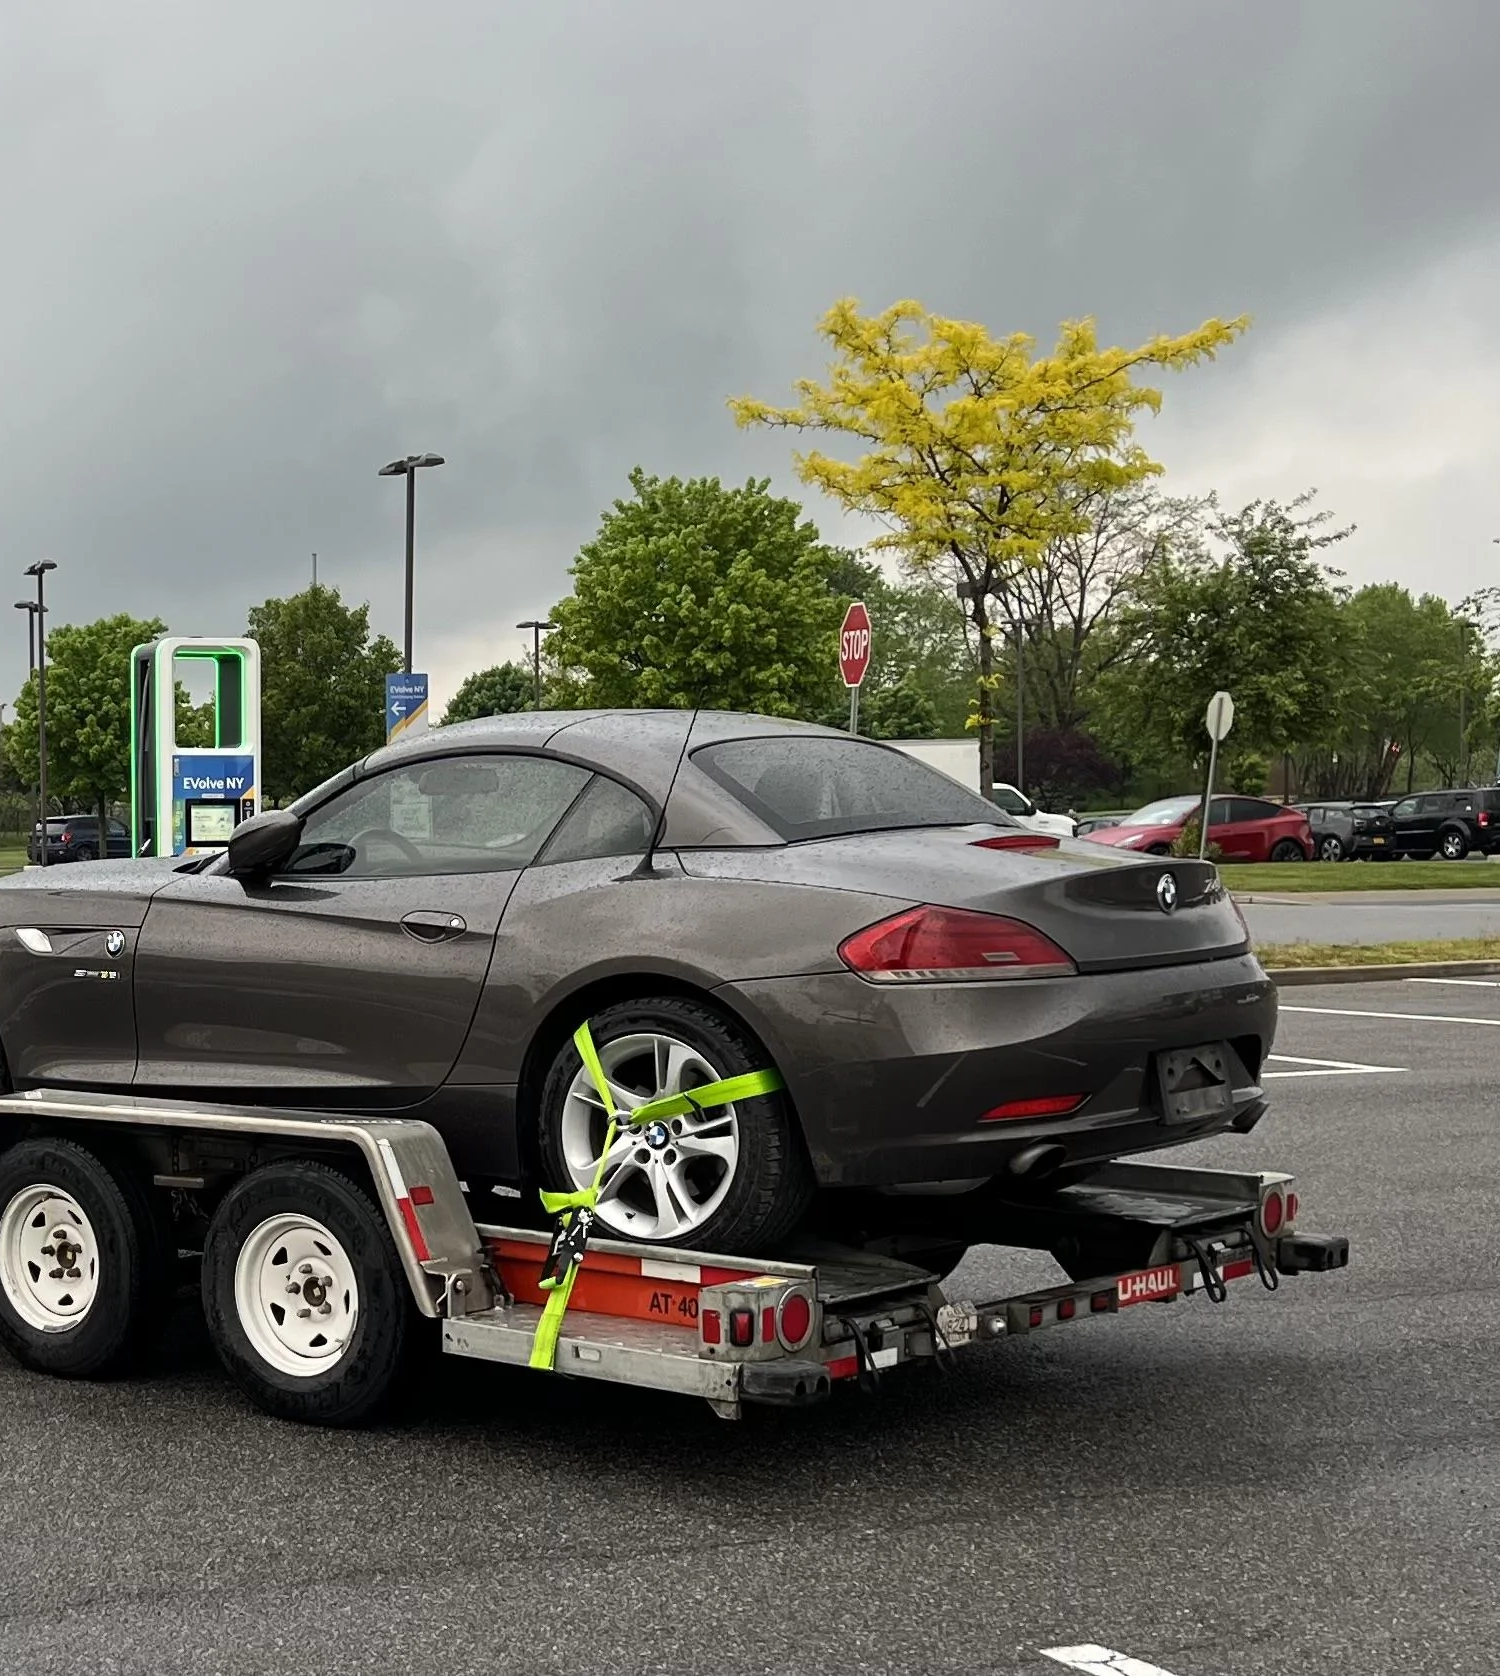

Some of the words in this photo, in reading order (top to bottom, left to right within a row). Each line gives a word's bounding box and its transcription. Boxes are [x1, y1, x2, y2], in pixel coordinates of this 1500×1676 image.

[842, 629, 868, 661] STOP
[414, 685, 425, 693] NY
[183, 776, 225, 790] EVolve
[226, 777, 245, 789] NY
[1117, 1268, 1177, 1301] U-HAUL
